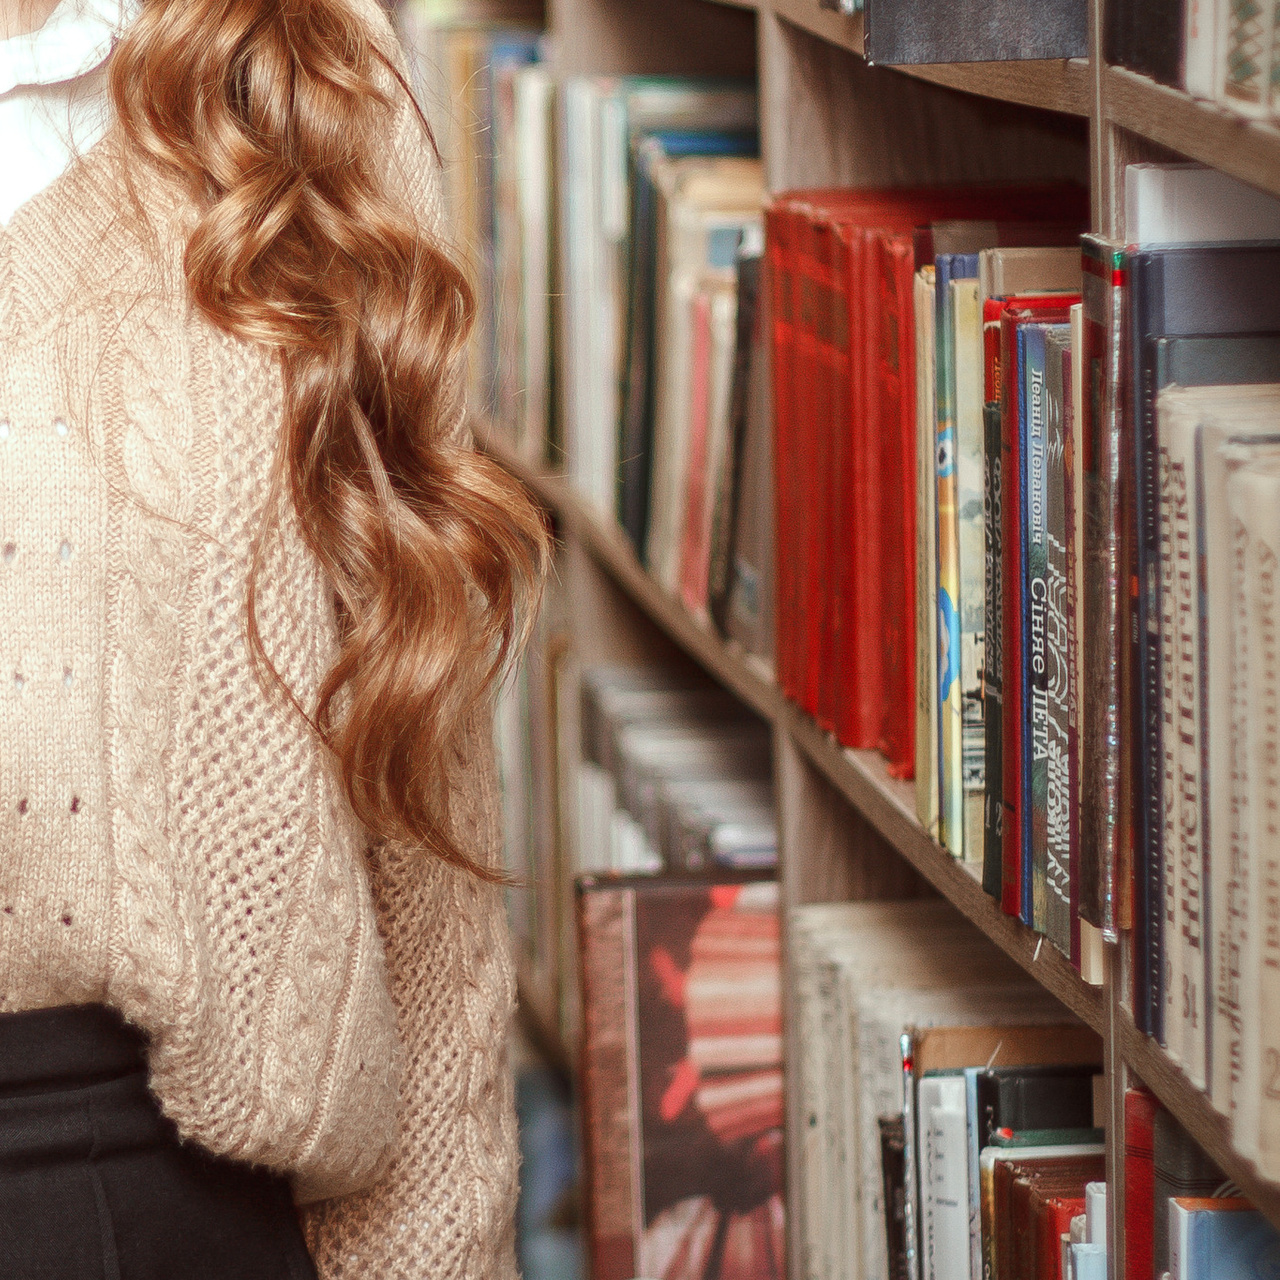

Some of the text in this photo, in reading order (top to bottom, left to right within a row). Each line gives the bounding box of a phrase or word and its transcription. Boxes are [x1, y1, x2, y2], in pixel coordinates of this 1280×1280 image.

[1030, 367, 1048, 763] Леанід Левановіч Сіняе ЛЕТА
